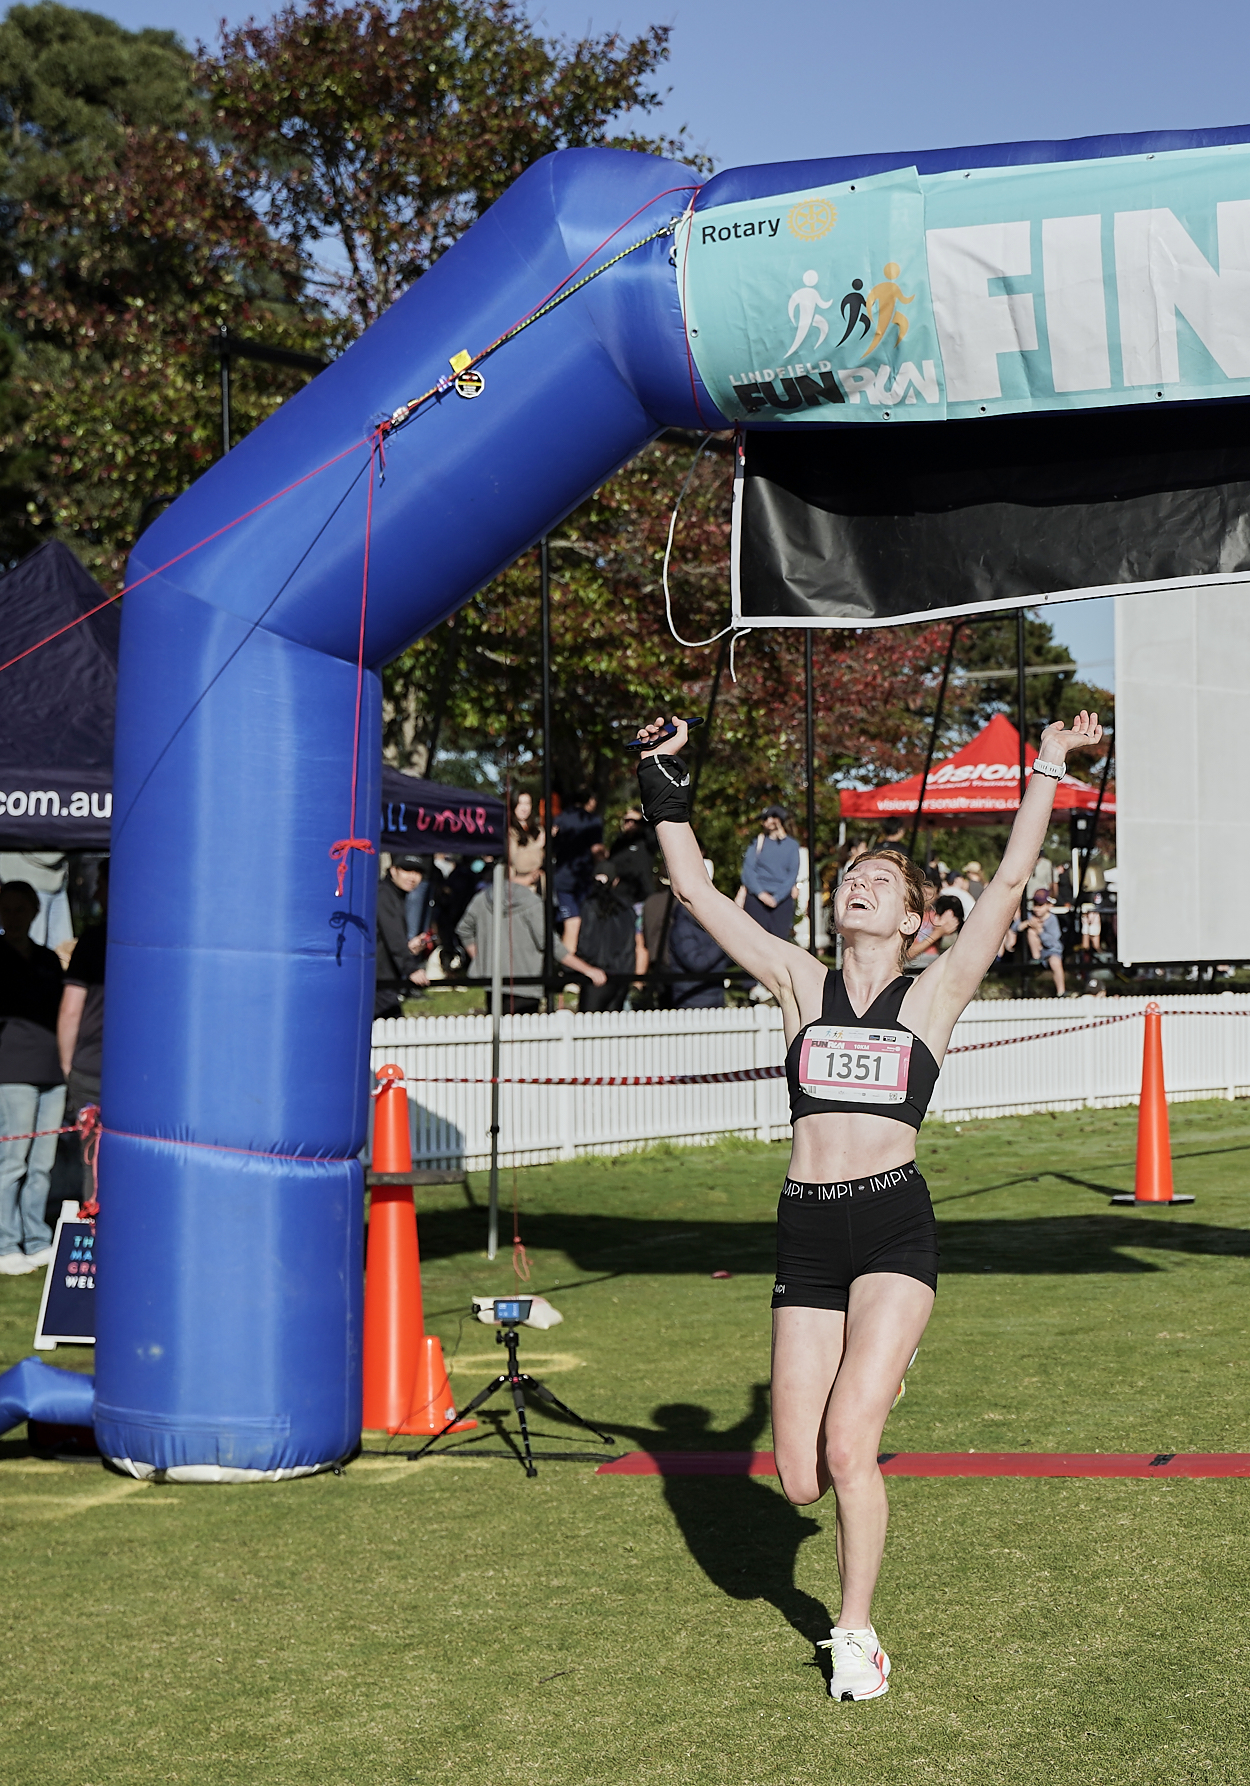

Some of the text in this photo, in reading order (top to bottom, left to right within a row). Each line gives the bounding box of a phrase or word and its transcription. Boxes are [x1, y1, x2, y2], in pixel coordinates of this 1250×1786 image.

[702, 218, 780, 245] Rotary
[729, 360, 832, 386] LINDFIELD
[381, 802, 408, 832] LL
[826, 1053, 882, 1081] 1351
[818, 1183, 853, 1201] IMPI
[869, 1168, 908, 1193] IMPI
[65, 1275, 95, 1289] WEL
